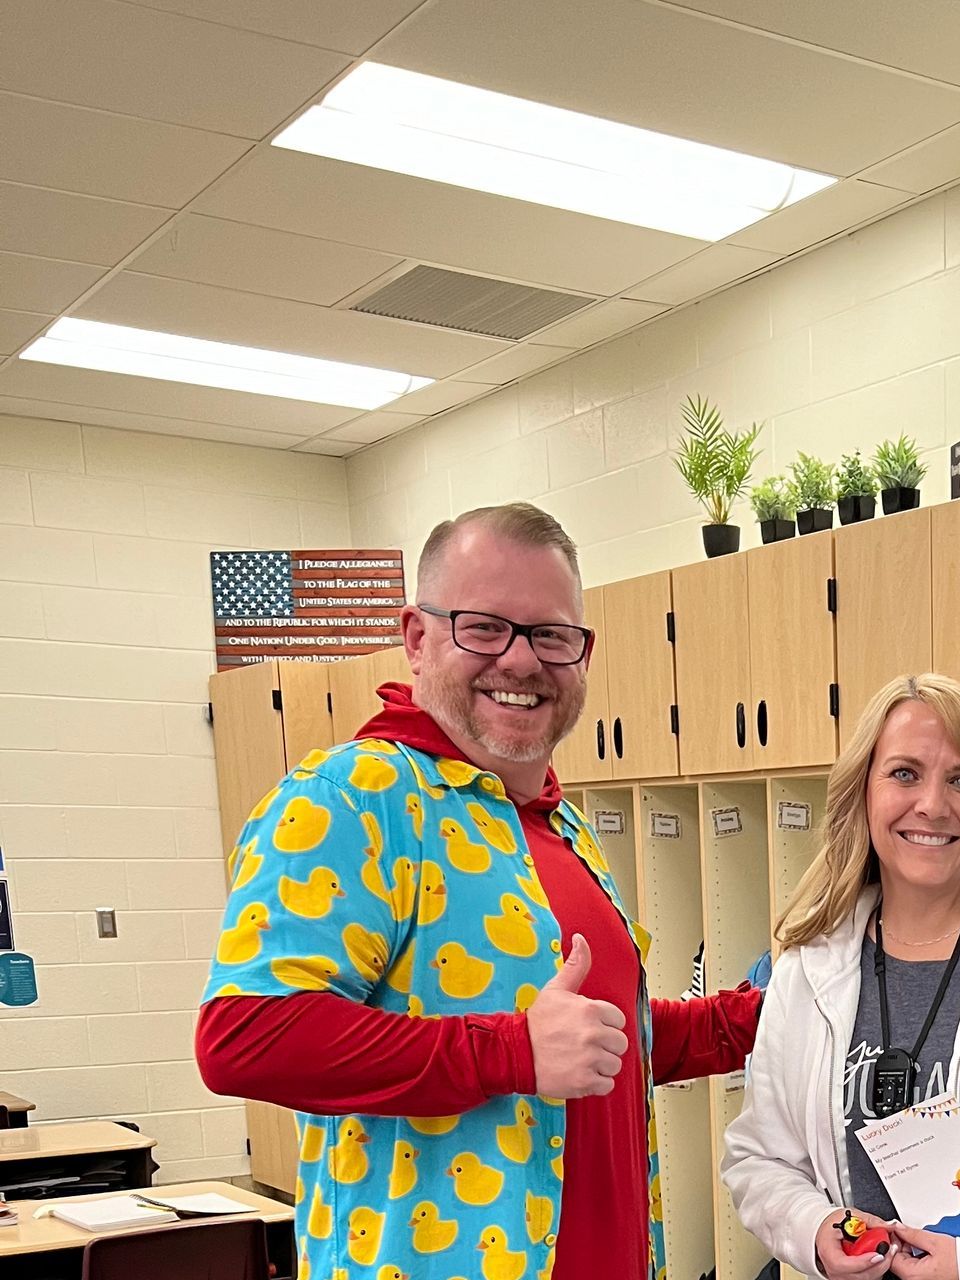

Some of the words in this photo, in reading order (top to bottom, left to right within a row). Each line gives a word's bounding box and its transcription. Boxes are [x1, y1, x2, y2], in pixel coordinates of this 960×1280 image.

[304, 560, 338, 569] PLEDGE
[339, 560, 394, 569] ALLEGIANCE
[303, 580, 316, 589] TO
[317, 580, 336, 589] THE
[336, 578, 358, 589] FLAG
[359, 580, 372, 589] OF
[372, 580, 391, 589] THE
[299, 597, 327, 608] UNITED
[327, 597, 352, 606] STATES
[225, 618, 242, 626] AND
[243, 618, 255, 626] TO
[255, 618, 272, 626] THE
[272, 617, 310, 627] REPUBLIC
[311, 618, 327, 626] FOR
[327, 618, 355, 626] WHICH
[228, 636, 249, 645] ONE
[250, 636, 283, 646] NATION
[284, 636, 316, 646] UNDER
[860, 1129, 883, 1142] Lucky
